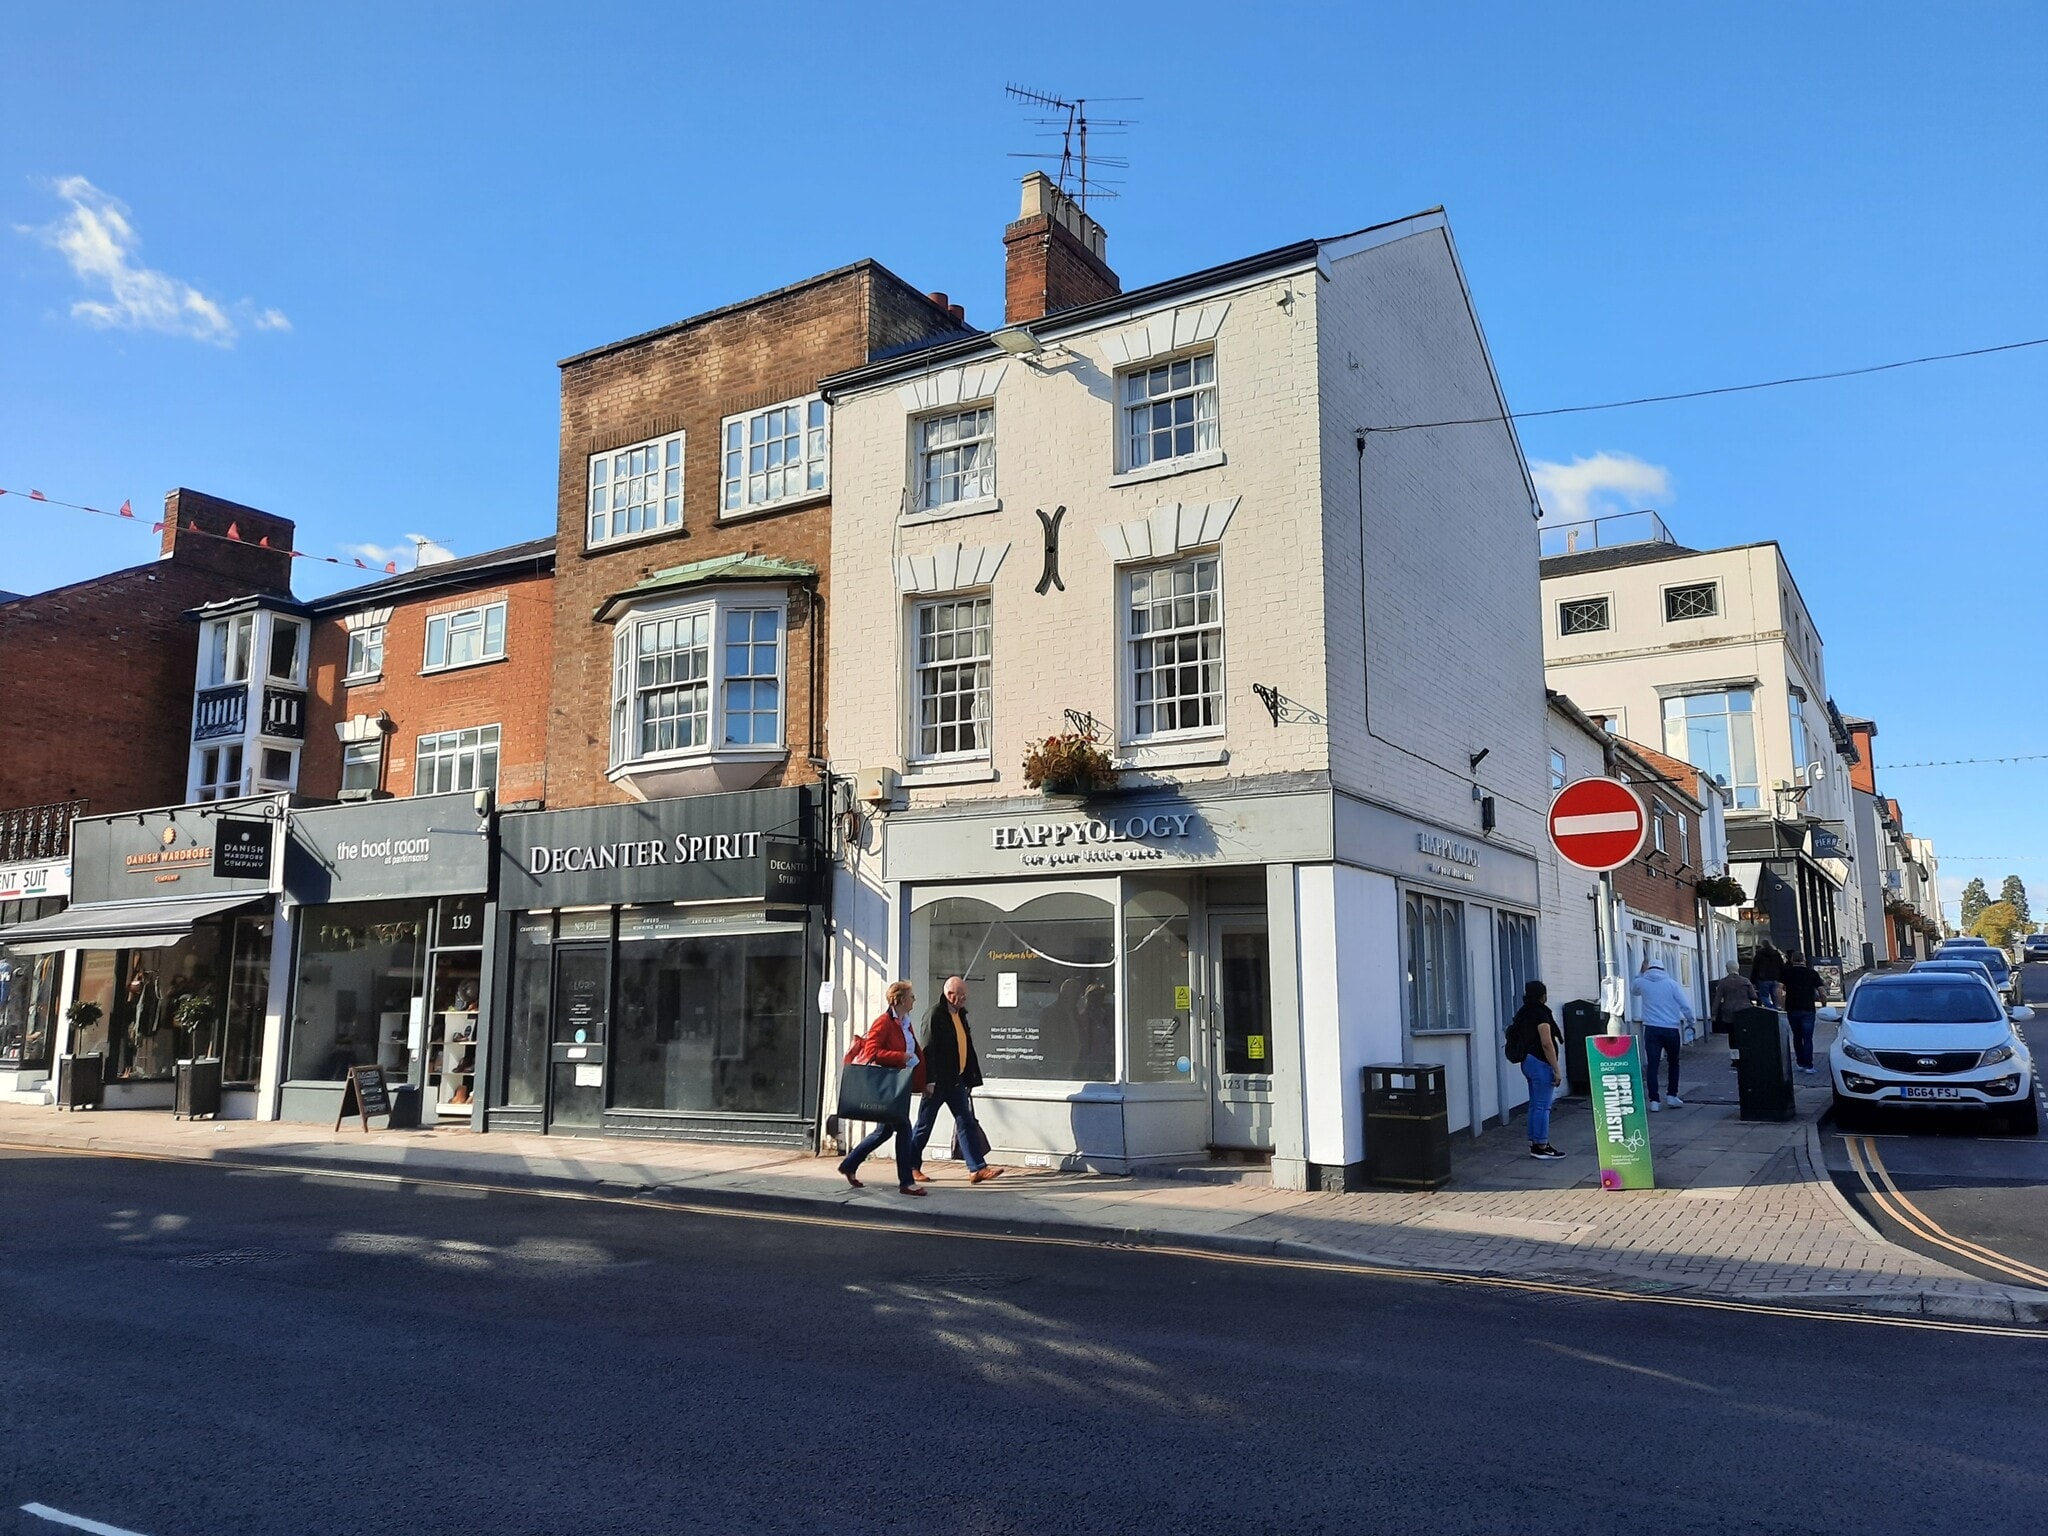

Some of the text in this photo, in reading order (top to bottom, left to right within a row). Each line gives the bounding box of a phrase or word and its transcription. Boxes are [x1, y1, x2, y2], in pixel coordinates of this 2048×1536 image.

[990, 814, 1193, 848] HAPPYOLOGY
[224, 843, 264, 854] DANISH
[337, 837, 430, 860] the boot room
[1419, 832, 1481, 868] HAPPYOLOGY
[1814, 838, 1842, 848] PIERRE
[126, 847, 212, 866] DANISH WARDROBE
[224, 852, 264, 860] WARDROBE
[529, 832, 761, 875] DECANTER SPIRIT
[1043, 850, 1074, 866] your
[1079, 848, 1117, 863] little
[1123, 847, 1158, 860] ones
[224, 859, 264, 868] COMPANY
[23, 869, 49, 888] SUIT
[451, 914, 472, 930] 119
[1223, 1079, 1241, 1090] 123
[1907, 1087, 1959, 1097] BG64 FSJ
[1618, 1074, 1635, 1116] OPEN &
[1601, 1074, 1625, 1143] OPTIMISTIC
